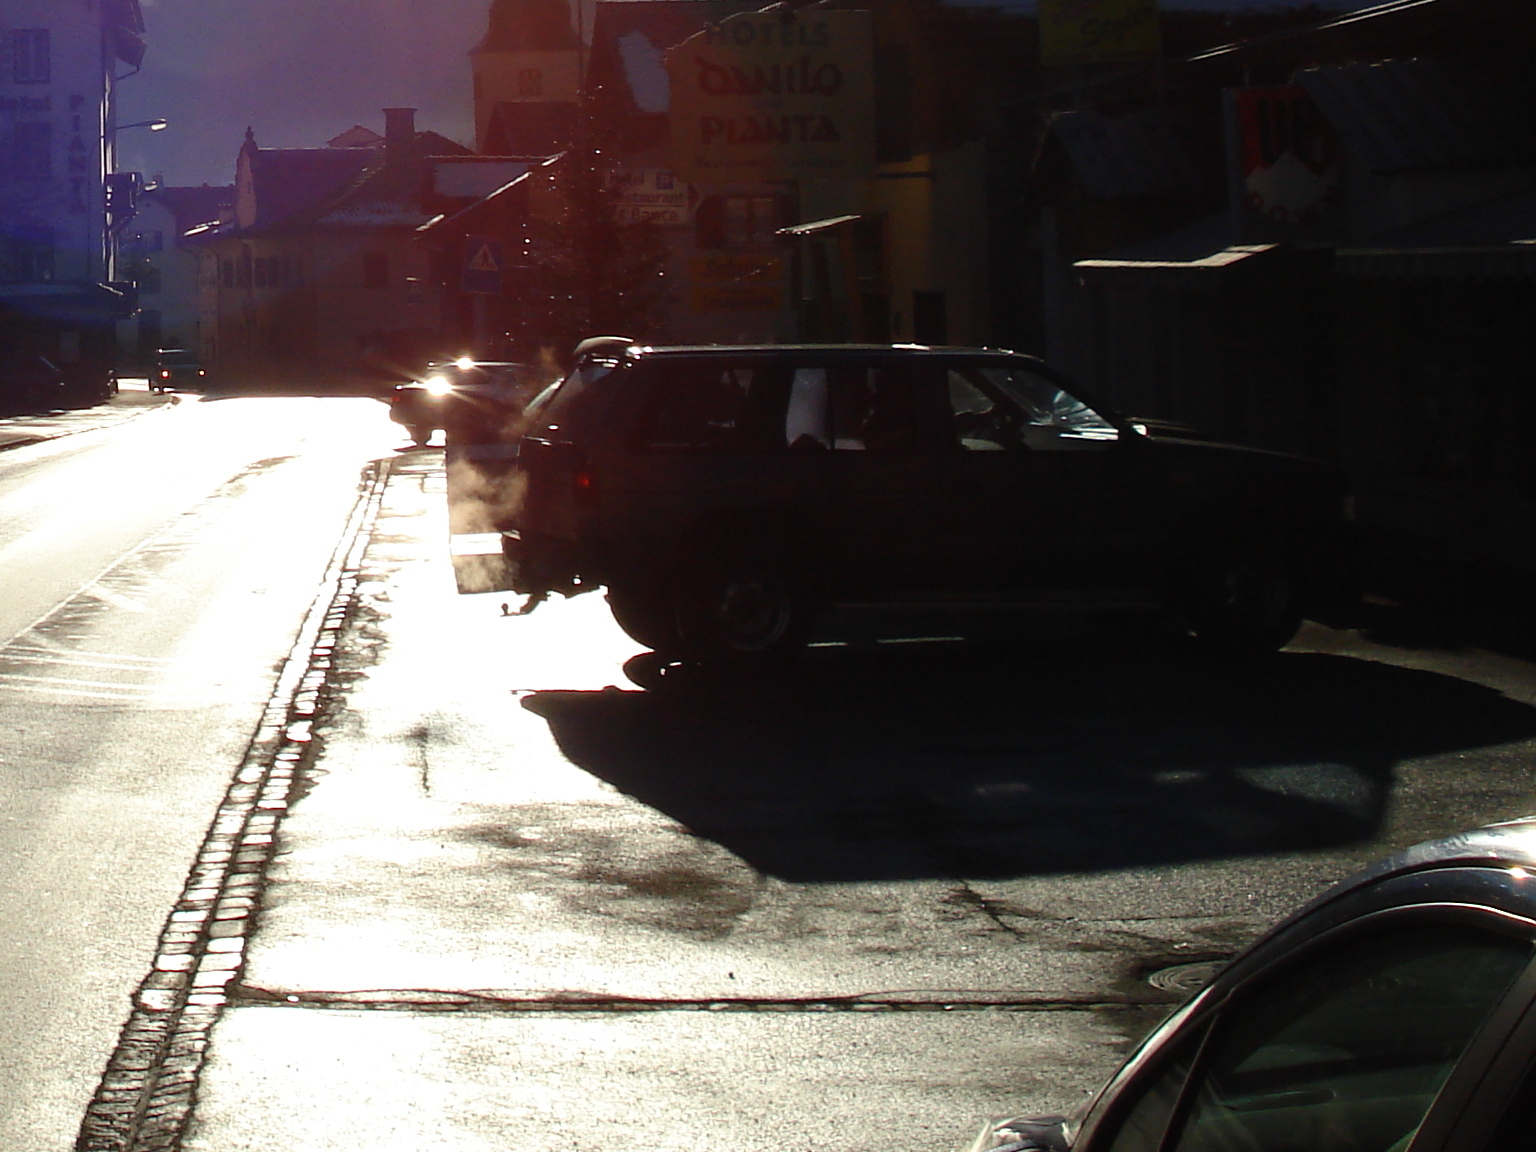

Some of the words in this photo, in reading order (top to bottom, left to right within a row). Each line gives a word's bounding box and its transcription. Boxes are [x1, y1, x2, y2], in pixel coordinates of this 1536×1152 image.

[703, 20, 831, 47] HOTELS
[693, 53, 844, 97] DANILO
[621, 192, 683, 203] staurant
